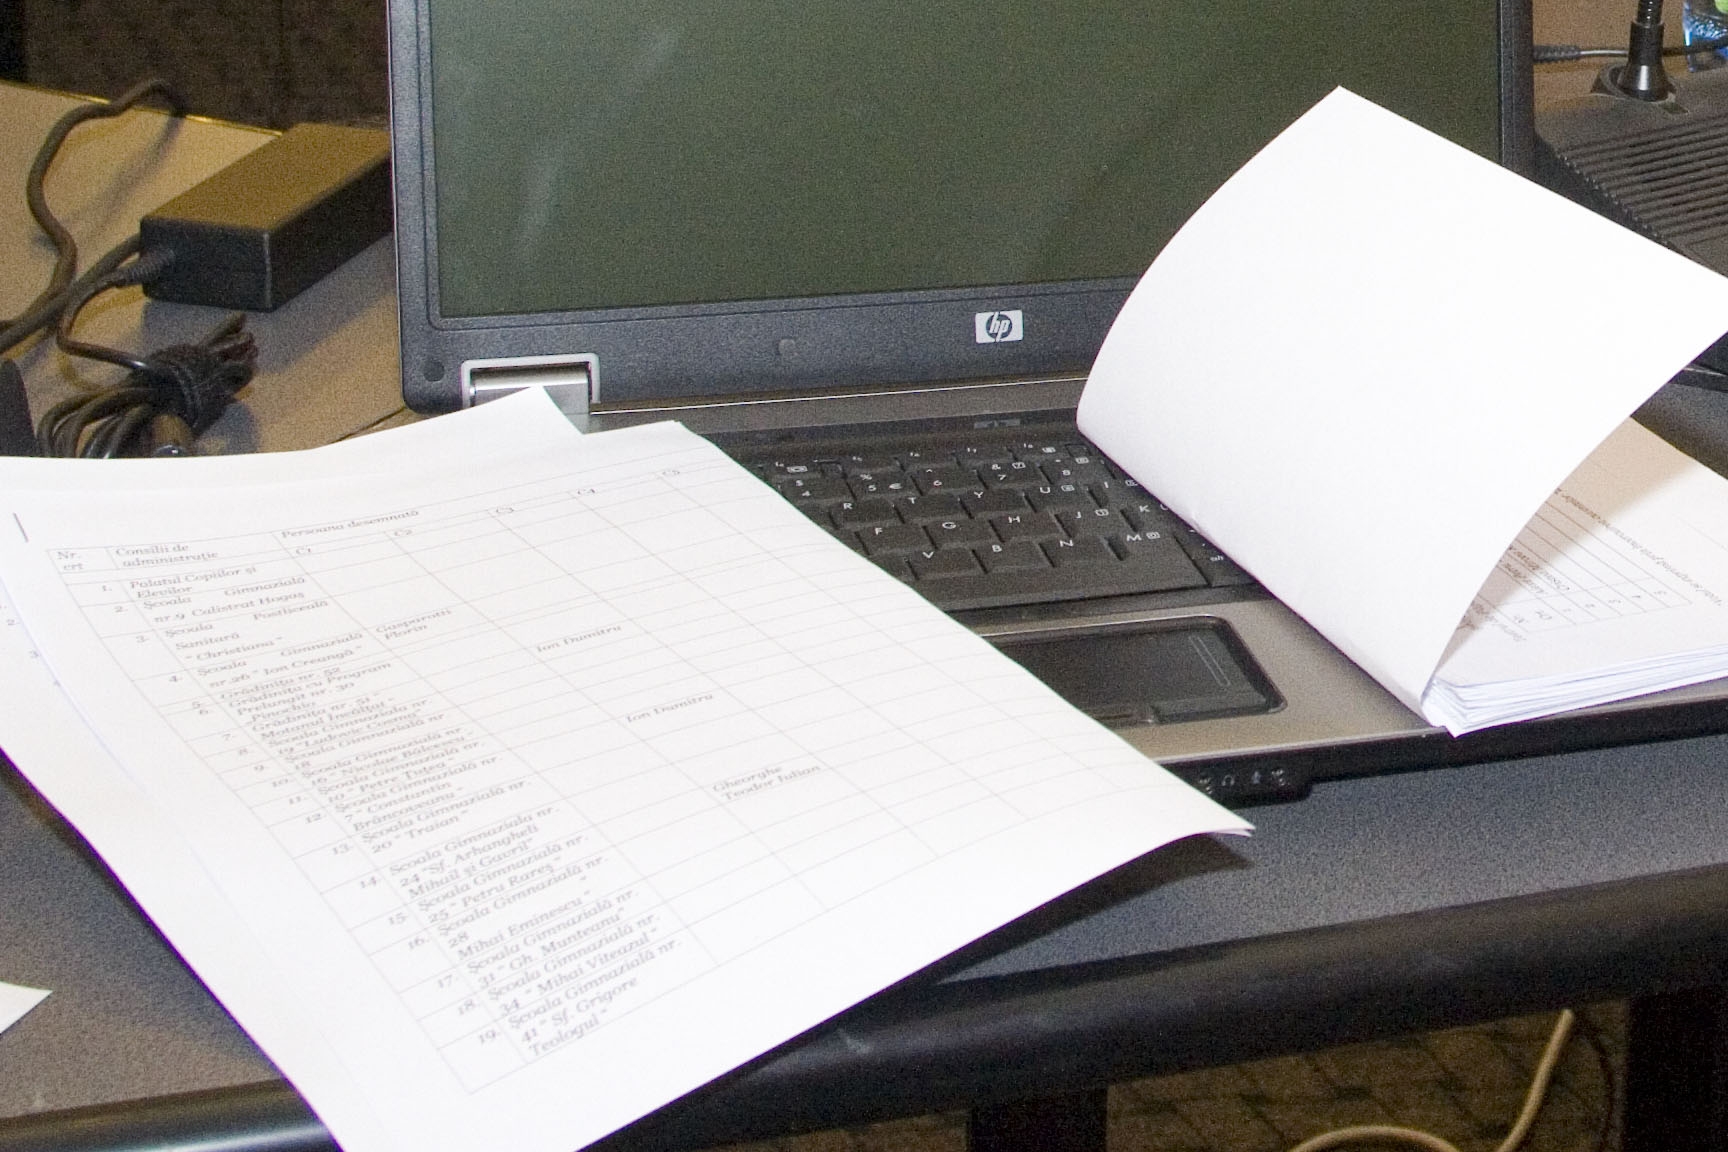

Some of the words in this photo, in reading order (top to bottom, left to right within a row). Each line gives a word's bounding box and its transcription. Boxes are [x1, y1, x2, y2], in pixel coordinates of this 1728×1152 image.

[114, 544, 170, 557] Consilii
[172, 543, 189, 553] de
[129, 576, 182, 590] Palatul
[408, 869, 460, 899] Mihail
[460, 881, 506, 910] Petru
[457, 932, 506, 962] Mihai
[506, 897, 584, 937] Eminescu
[536, 965, 585, 997] Mihai
[585, 931, 650, 970] Viteazul
[527, 1015, 601, 1058] Teologul
